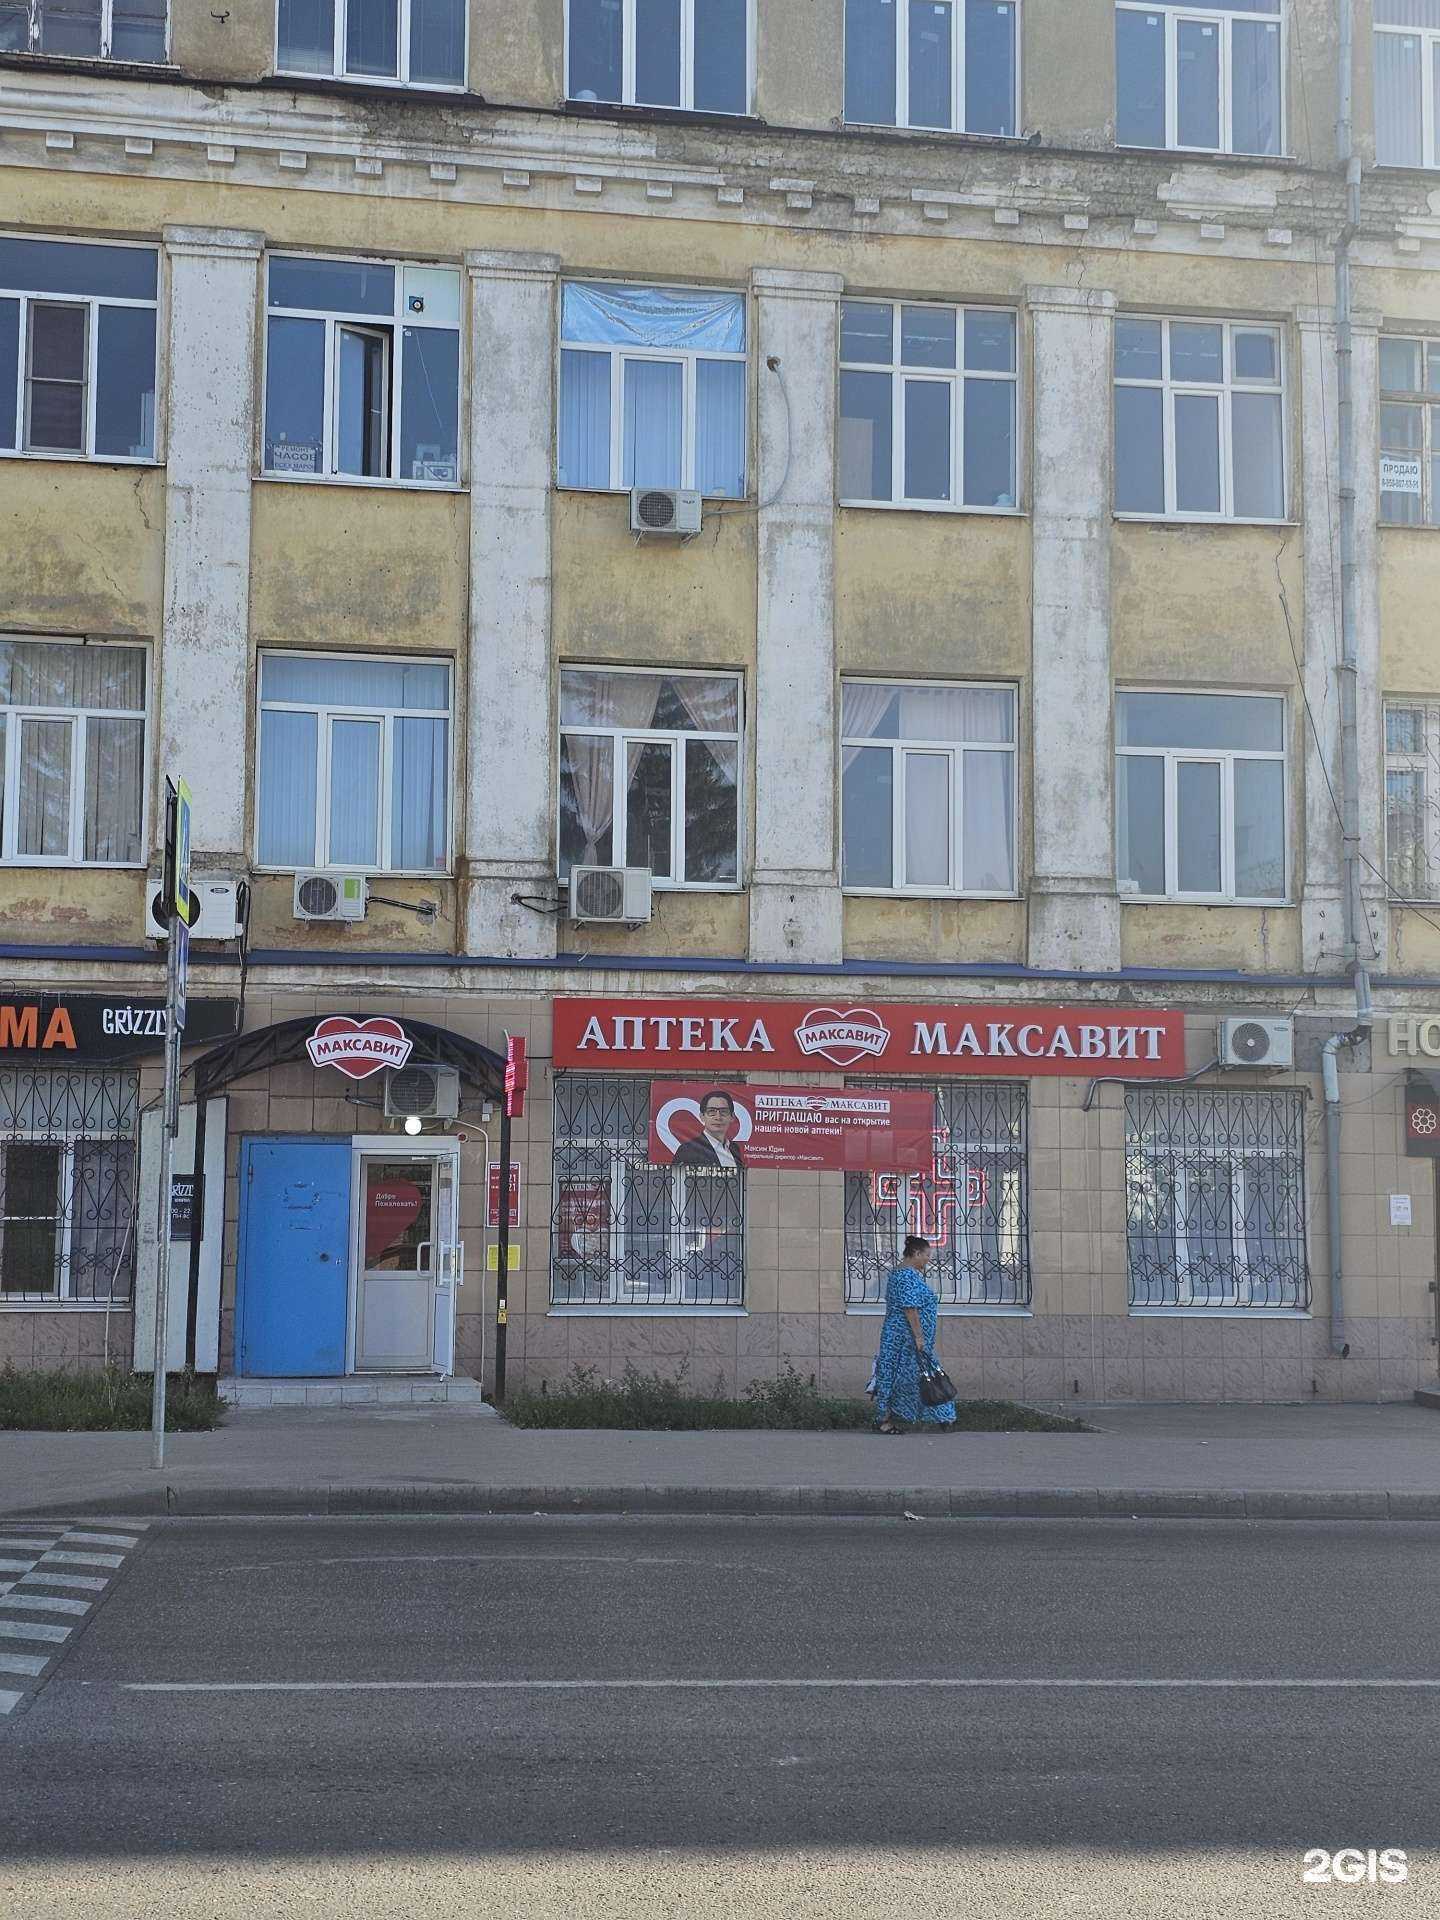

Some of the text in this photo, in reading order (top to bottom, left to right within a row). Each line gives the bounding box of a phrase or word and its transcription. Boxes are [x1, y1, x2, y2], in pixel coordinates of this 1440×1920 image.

[1383, 463, 1418, 475] ПРОДАЮ
[0, 1006, 78, 1049] МА
[577, 1016, 1166, 1060] АПТЕКА МАКСАВИТ МАКСАВИТ
[316, 1038, 403, 1057] МАКСАВИТ
[757, 1097, 889, 1111] АПТЕКА МАКСАВИТ
[755, 1110, 891, 1126] ПРИГЛАШАЮ вас на открытие
[754, 1124, 843, 1135] нашей новой аптеки!
